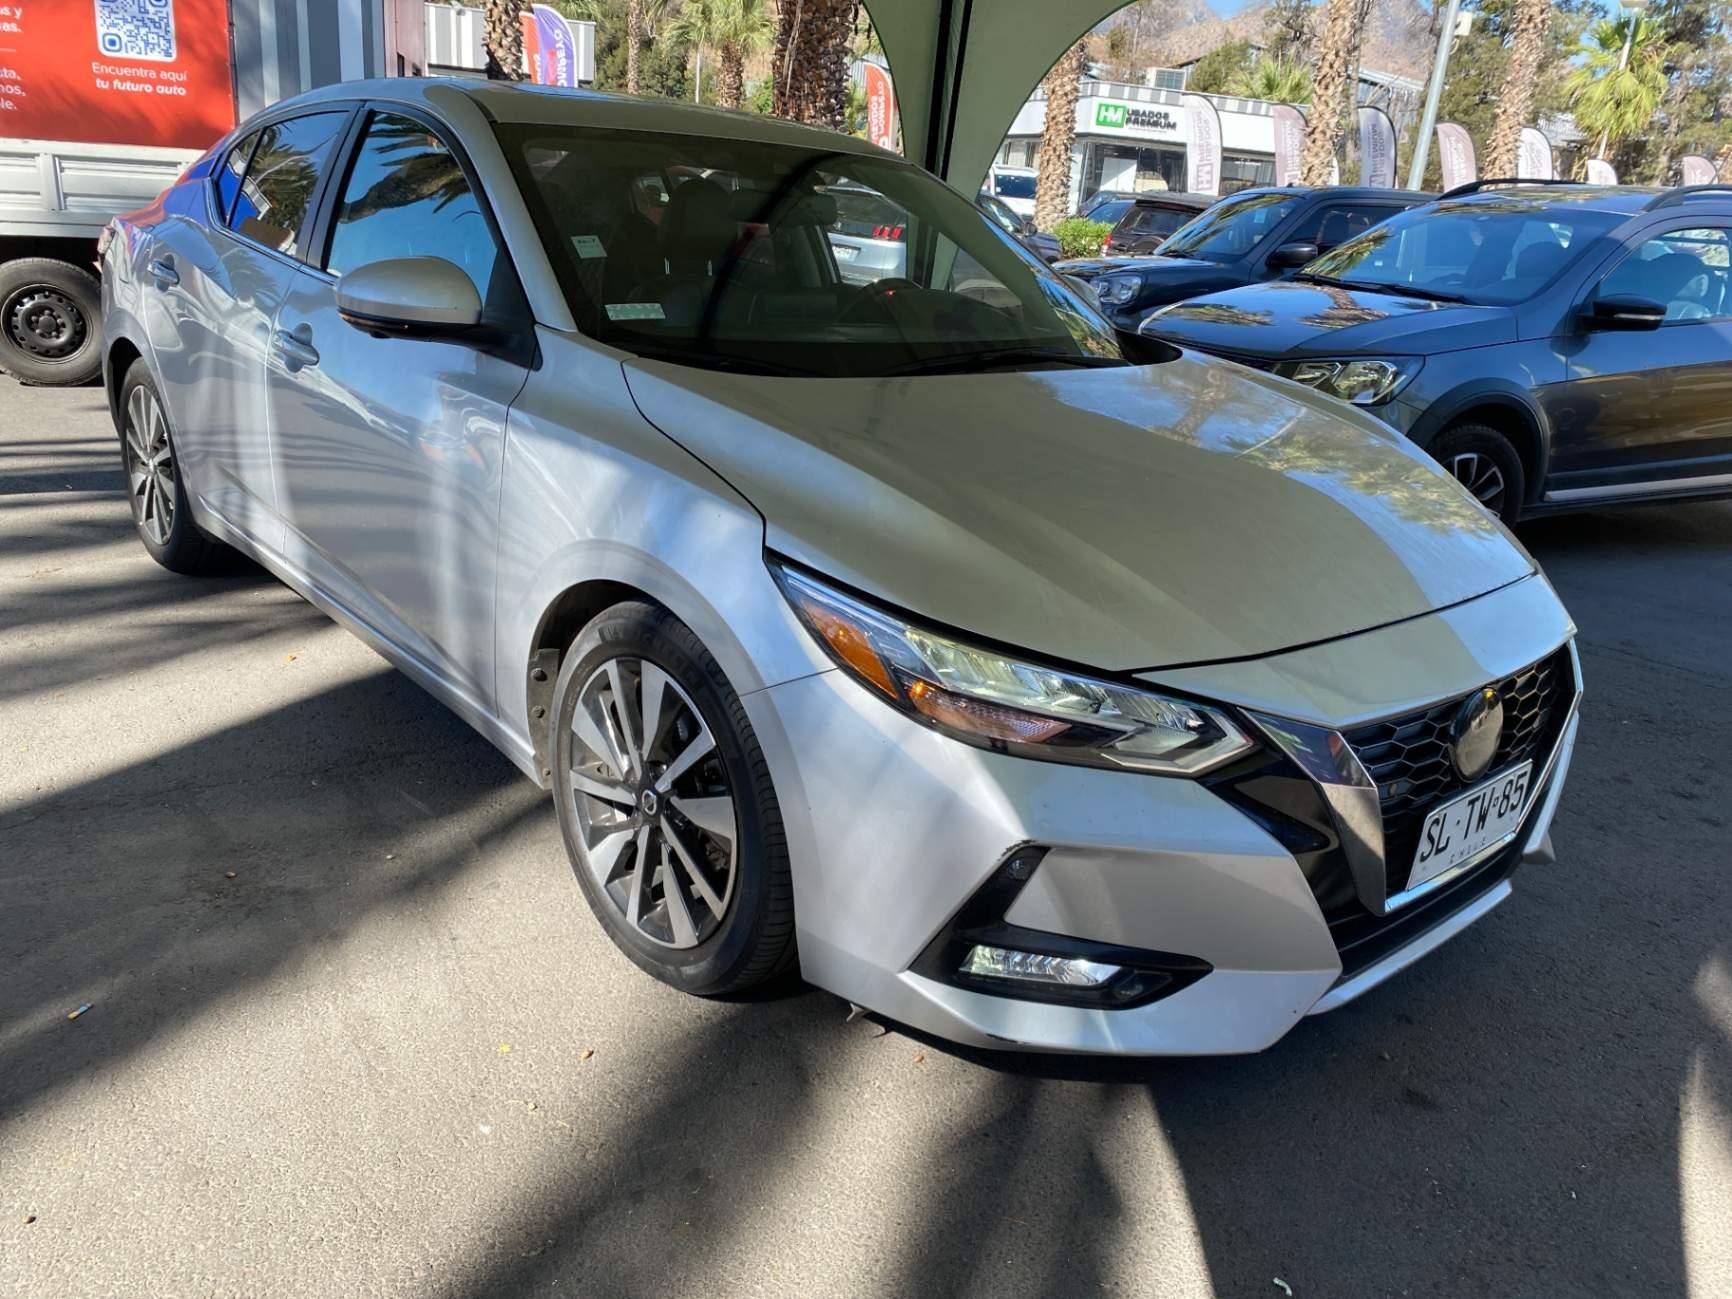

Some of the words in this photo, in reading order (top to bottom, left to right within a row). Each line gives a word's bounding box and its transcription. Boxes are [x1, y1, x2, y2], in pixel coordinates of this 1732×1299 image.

[92, 62, 156, 79] Encuentra
[160, 70, 188, 82] aquí
[96, 78, 109, 89] tu
[113, 78, 153, 93] futuro
[156, 84, 186, 96] auto
[1099, 105, 1124, 124] HM
[1127, 108, 1169, 120] USADOS
[1126, 117, 1177, 130] PREMIUM
